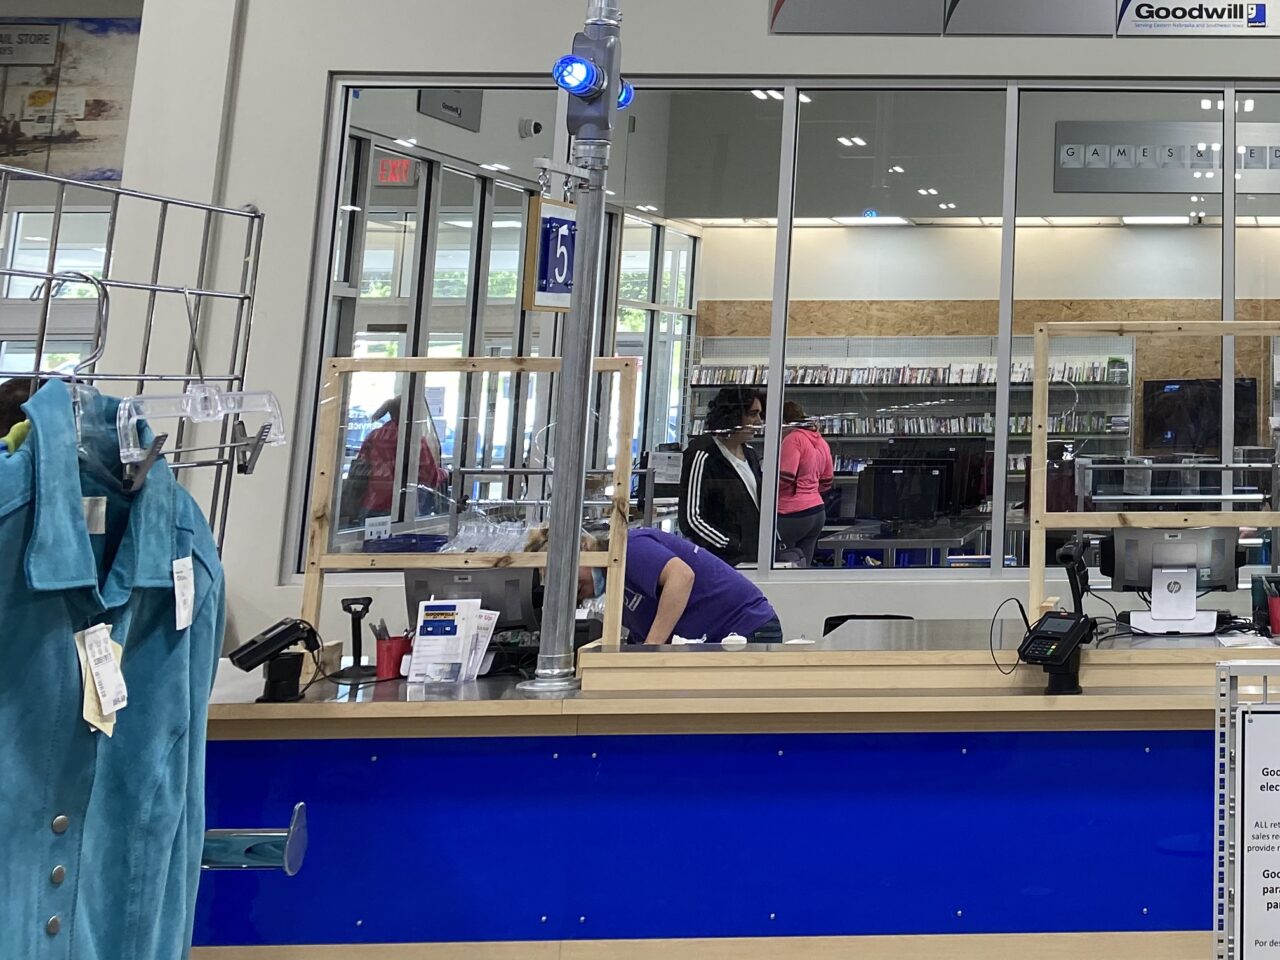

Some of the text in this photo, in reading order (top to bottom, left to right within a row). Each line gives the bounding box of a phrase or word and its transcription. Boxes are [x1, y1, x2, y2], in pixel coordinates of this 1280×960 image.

[1135, 4, 1244, 19] Goodwill
[16, 34, 50, 44] STORE
[1066, 148, 1174, 159] GAMES
[378, 160, 410, 183] EXIT
[554, 224, 568, 284] 5
[1167, 581, 1181, 594] hp
[1254, 821, 1269, 829] ALL
[1251, 832, 1270, 841] sales
[1246, 844, 1276, 854] provide
[1254, 939, 1268, 948] Por
